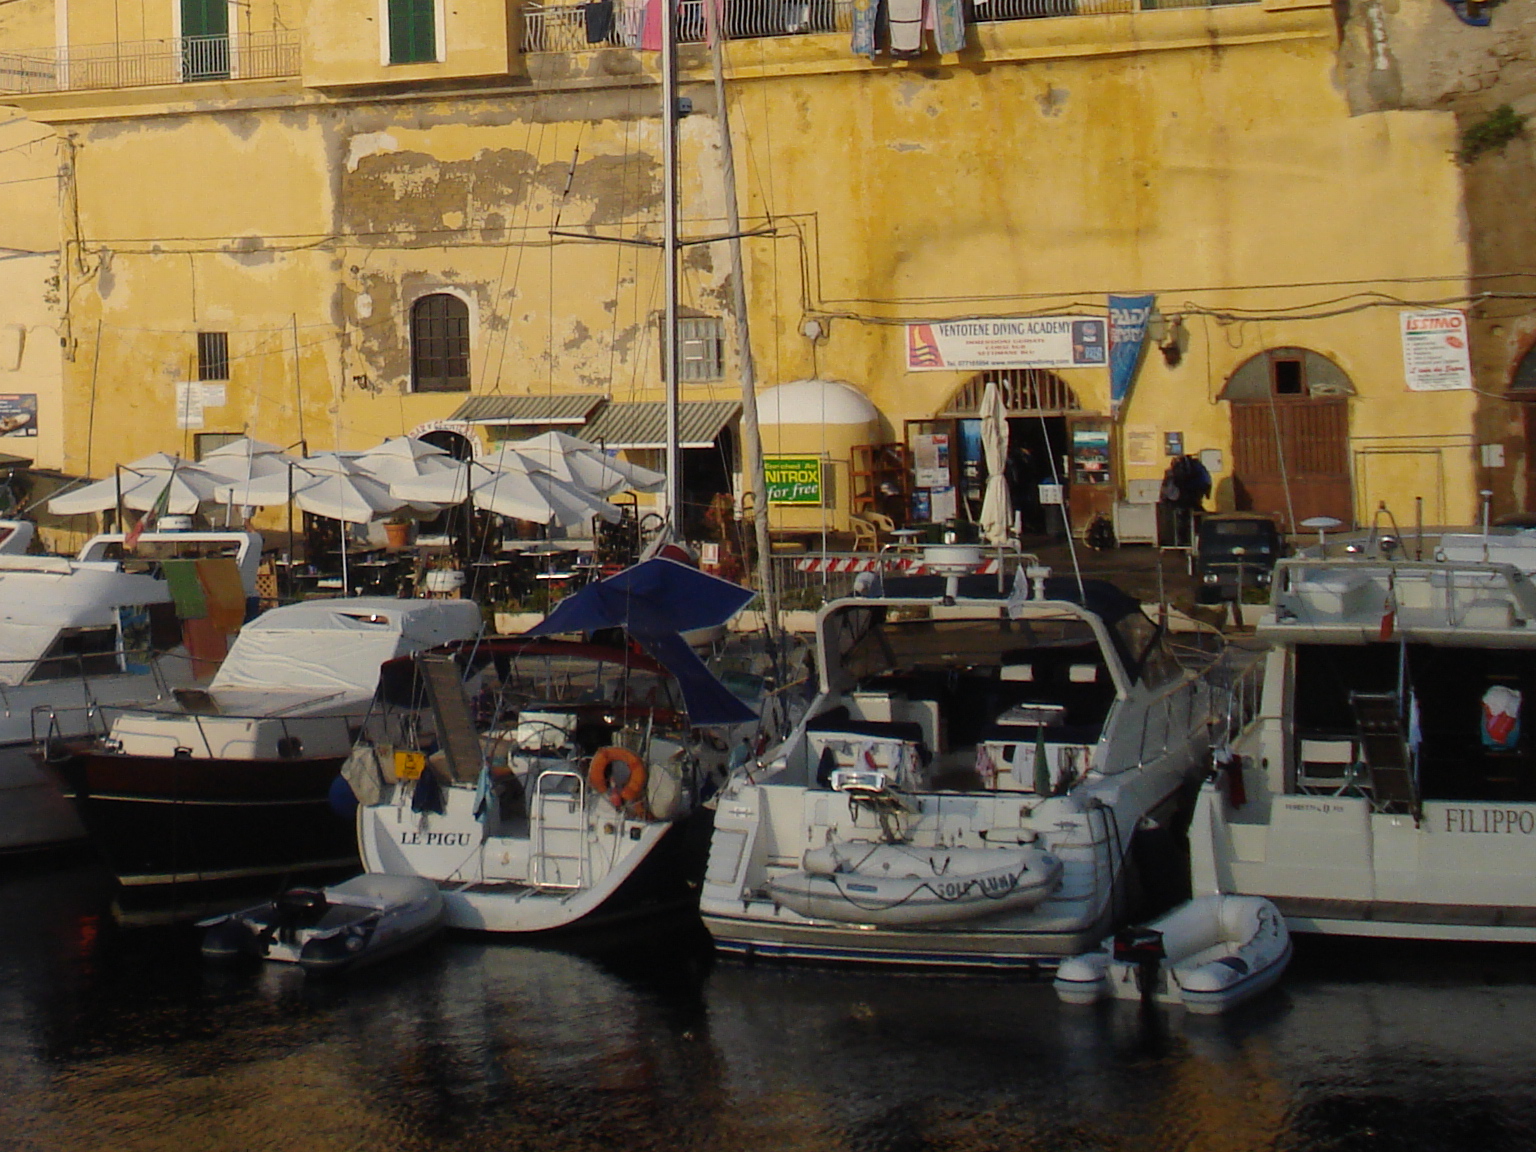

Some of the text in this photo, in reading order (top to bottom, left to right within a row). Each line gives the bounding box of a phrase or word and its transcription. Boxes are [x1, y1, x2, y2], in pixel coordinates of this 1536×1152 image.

[939, 321, 1071, 337] VENTOTENE DIVING ACADEMY
[765, 470, 818, 483] NITROX
[767, 482, 818, 502] for free
[1445, 807, 1535, 834] FILIPPO
[401, 832, 471, 846] LE PIGU
